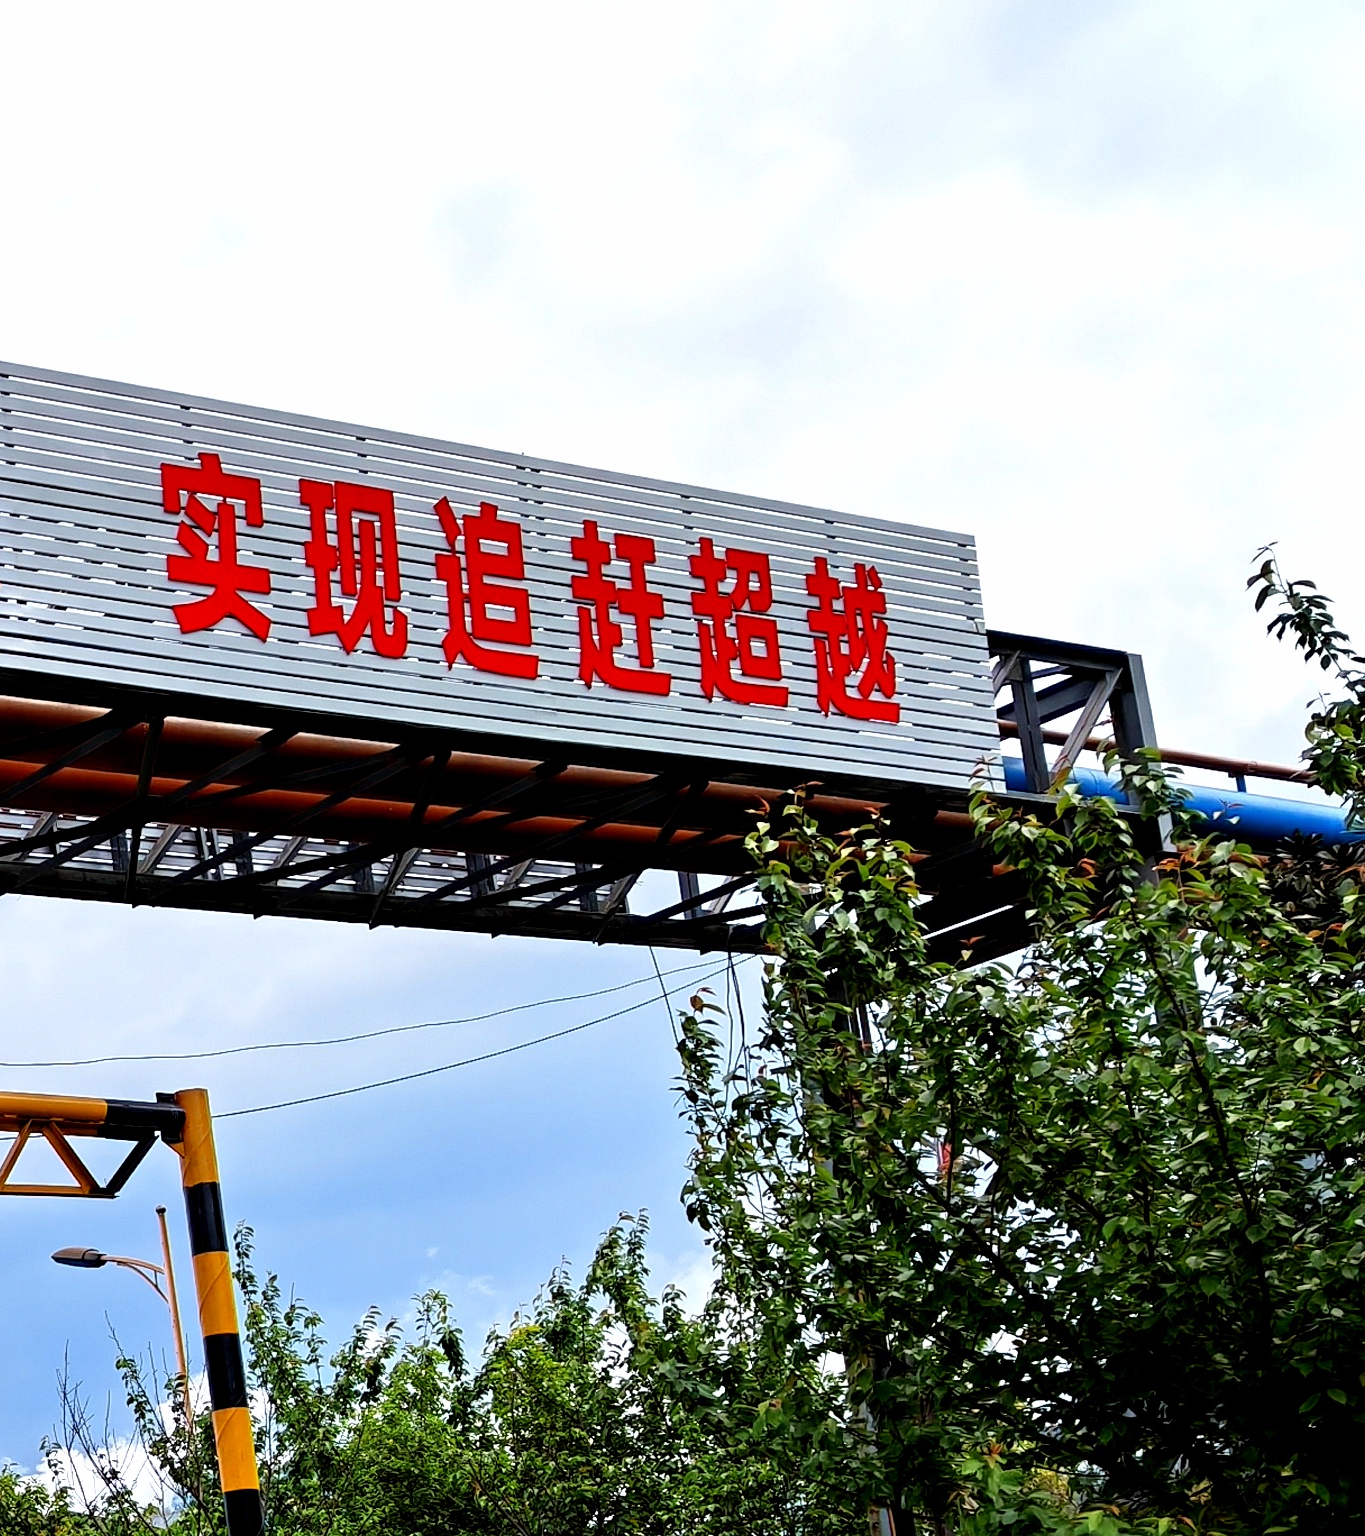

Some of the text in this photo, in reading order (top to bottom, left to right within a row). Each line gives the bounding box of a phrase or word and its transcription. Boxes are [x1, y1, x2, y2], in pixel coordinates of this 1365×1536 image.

[160, 454, 901, 724] 实现追赶超越
